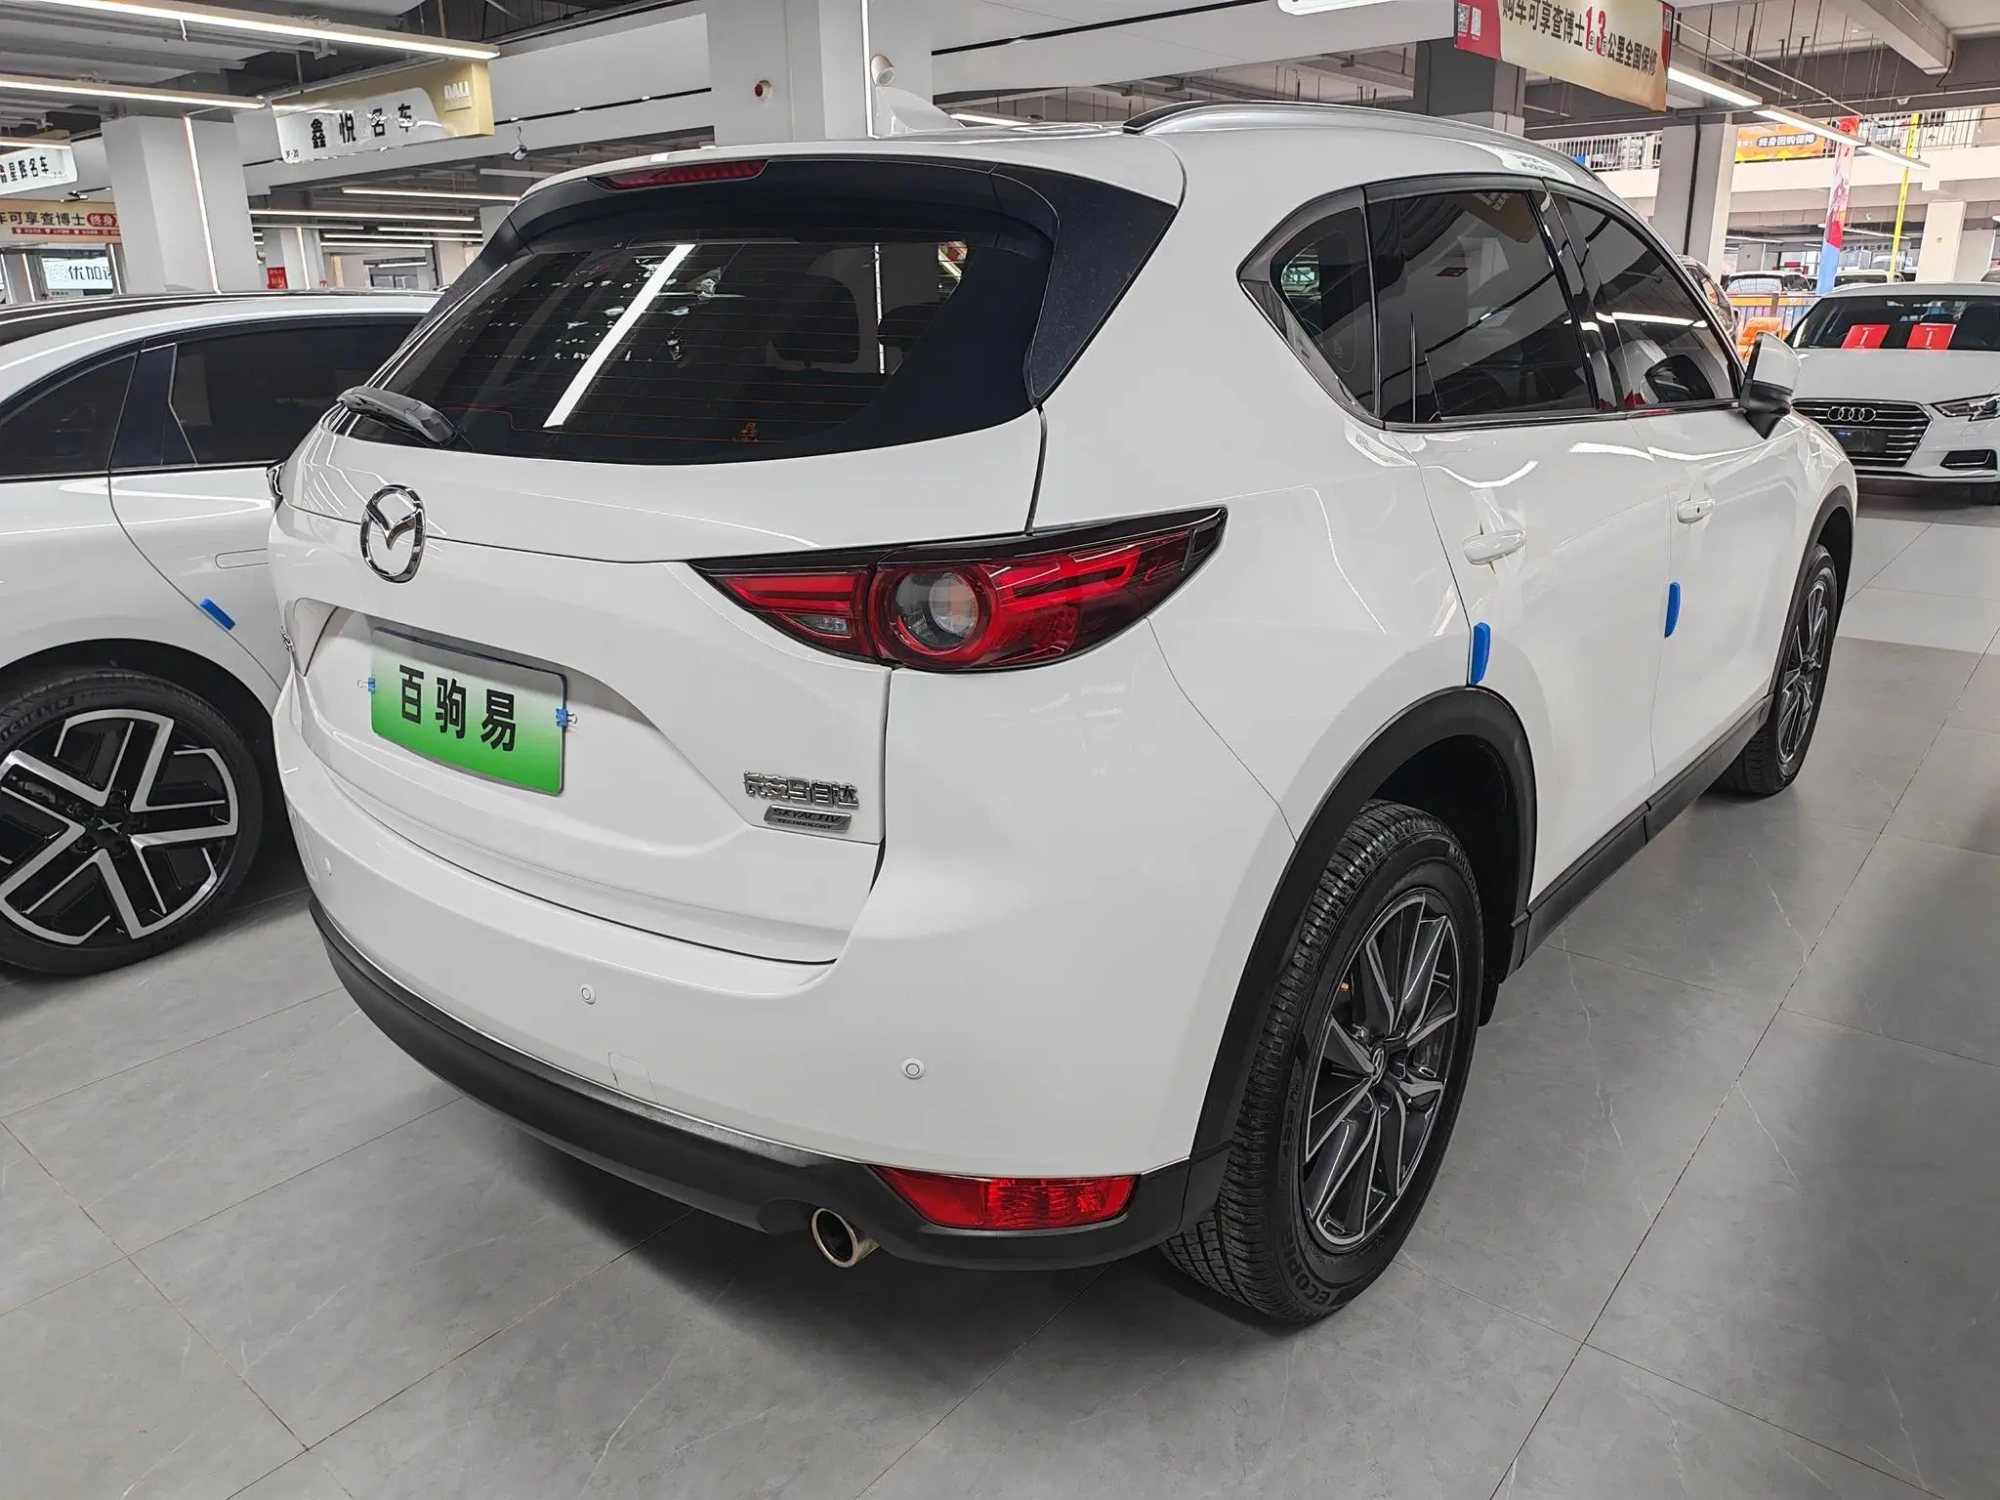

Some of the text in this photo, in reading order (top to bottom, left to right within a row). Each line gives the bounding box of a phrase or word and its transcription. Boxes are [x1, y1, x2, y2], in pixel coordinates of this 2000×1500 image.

[310, 103, 413, 149] 鑫悦名车
[399, 664, 517, 752] 百驹易
[772, 808, 842, 823] SKYACTIV
[776, 818, 835, 830] TECHNOLOGY
